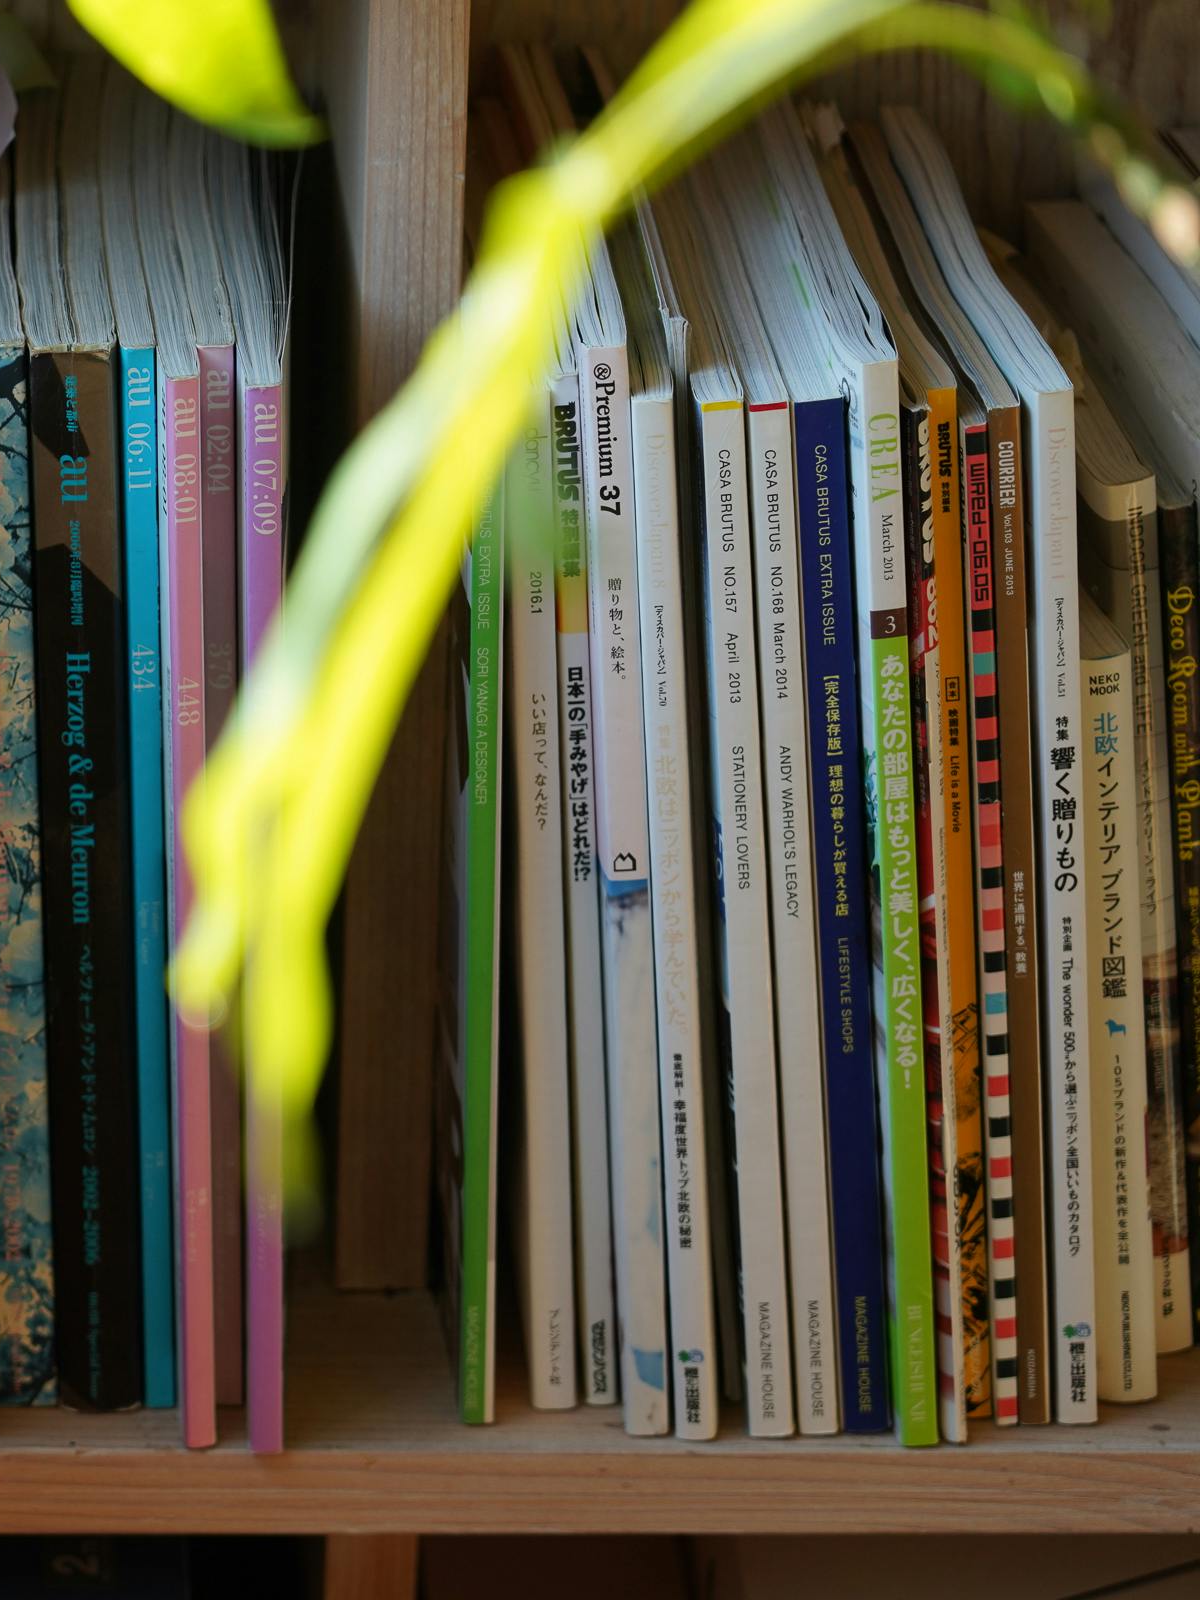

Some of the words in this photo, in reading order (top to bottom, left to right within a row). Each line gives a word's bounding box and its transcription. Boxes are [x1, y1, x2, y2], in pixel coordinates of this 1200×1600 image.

[127, 422, 153, 492] 06:11
[207, 424, 232, 495] 02:04
[718, 449, 733, 488] CASA
[764, 449, 778, 489] CASA
[814, 444, 828, 483] CASA
[868, 412, 901, 503] CREA
[937, 422, 952, 477] BRUTUS
[172, 453, 197, 527] 08:01
[252, 460, 278, 536] 07:09
[599, 485, 621, 516] 37
[720, 493, 735, 553] BRUTUS
[767, 494, 781, 553] BRUTUS
[817, 487, 831, 546] BRUTUS
[881, 514, 895, 554] March
[1003, 513, 1013, 544] Vol.103
[1004, 548, 1014, 573] JUNE
[1126, 505, 1148, 577] INDOOR
[478, 546, 493, 587] EXTRA
[819, 554, 834, 599] EXTRA
[883, 556, 895, 581] 2013
[1005, 575, 1015, 596] 2013
[478, 592, 490, 630] ISSUE
[530, 571, 543, 615] 2016.1
[723, 566, 738, 613] NO.157
[770, 566, 784, 614] NO.168
[822, 603, 836, 646] ISSUE
[883, 615, 896, 634] 3
[1131, 583, 1149, 648] GREEN
[1167, 585, 1197, 650] Deco
[477, 647, 490, 677] SORI
[725, 632, 740, 664] April
[773, 622, 787, 664] March
[130, 643, 157, 693] 434
[728, 672, 742, 704] 2013
[775, 669, 789, 700] 2014
[1089, 676, 1120, 686] NEKO
[1133, 655, 1148, 687] and
[1166, 655, 1198, 726] Room
[61, 650, 93, 748] Herzog
[177, 677, 200, 727] 448
[1089, 687, 1120, 697] MOOK
[1135, 695, 1153, 736] LIFE
[68, 754, 94, 776] &
[475, 742, 488, 805] DESIGNER
[779, 745, 793, 783] ANDY
[950, 755, 963, 776] Life
[1173, 732, 1193, 775] with
[68, 783, 94, 816] de
[732, 745, 749, 831] STATIONERY
[951, 779, 962, 789] is
[782, 787, 796, 859] WARHOL'S
[952, 801, 963, 833] Movie
[1050, 747, 1078, 892] 響く贈りもの
[1176, 779, 1200, 861] Plants
[71, 822, 97, 925] Meuron
[736, 835, 751, 890] LOVERS
[785, 864, 799, 919] LEGACY
[837, 937, 852, 1005] LIFESTYLE
[1062, 957, 1074, 982] The
[1063, 984, 1075, 1028] wonder
[840, 1008, 854, 1054] SHOPS
[758, 1300, 773, 1369] MAGAZINE
[807, 1299, 822, 1368] MAGAZINE
[853, 1295, 869, 1364] MAGAZINE
[761, 1373, 775, 1419] HOUSE
[810, 1372, 825, 1416] HOUSE
[858, 1367, 872, 1414] HOUSE
